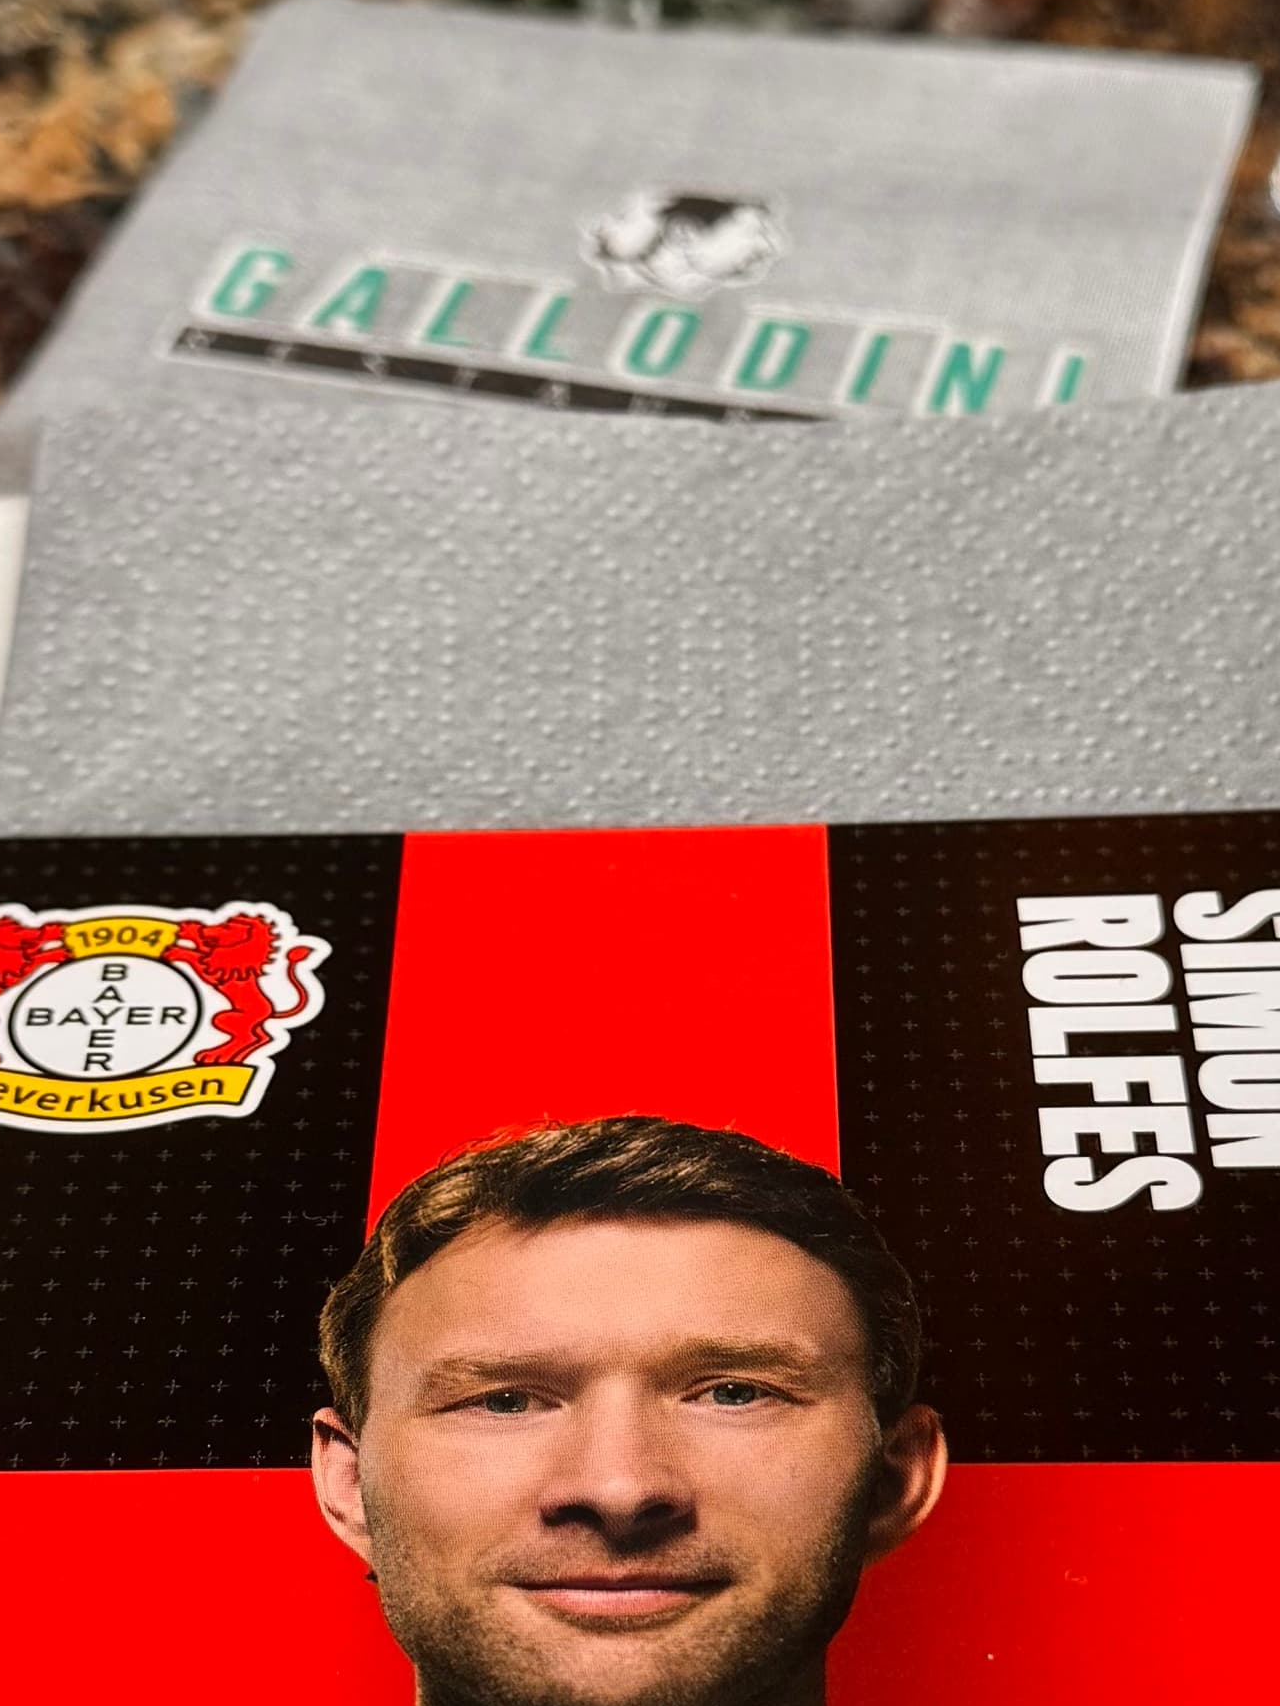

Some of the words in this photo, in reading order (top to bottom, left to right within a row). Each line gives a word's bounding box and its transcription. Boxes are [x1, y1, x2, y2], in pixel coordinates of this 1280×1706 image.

[211, 248, 1086, 417] GALLODINI
[75, 926, 165, 949] 1904
[24, 1006, 188, 1027] BAYER
[1016, 894, 1204, 1213] ROLFES
